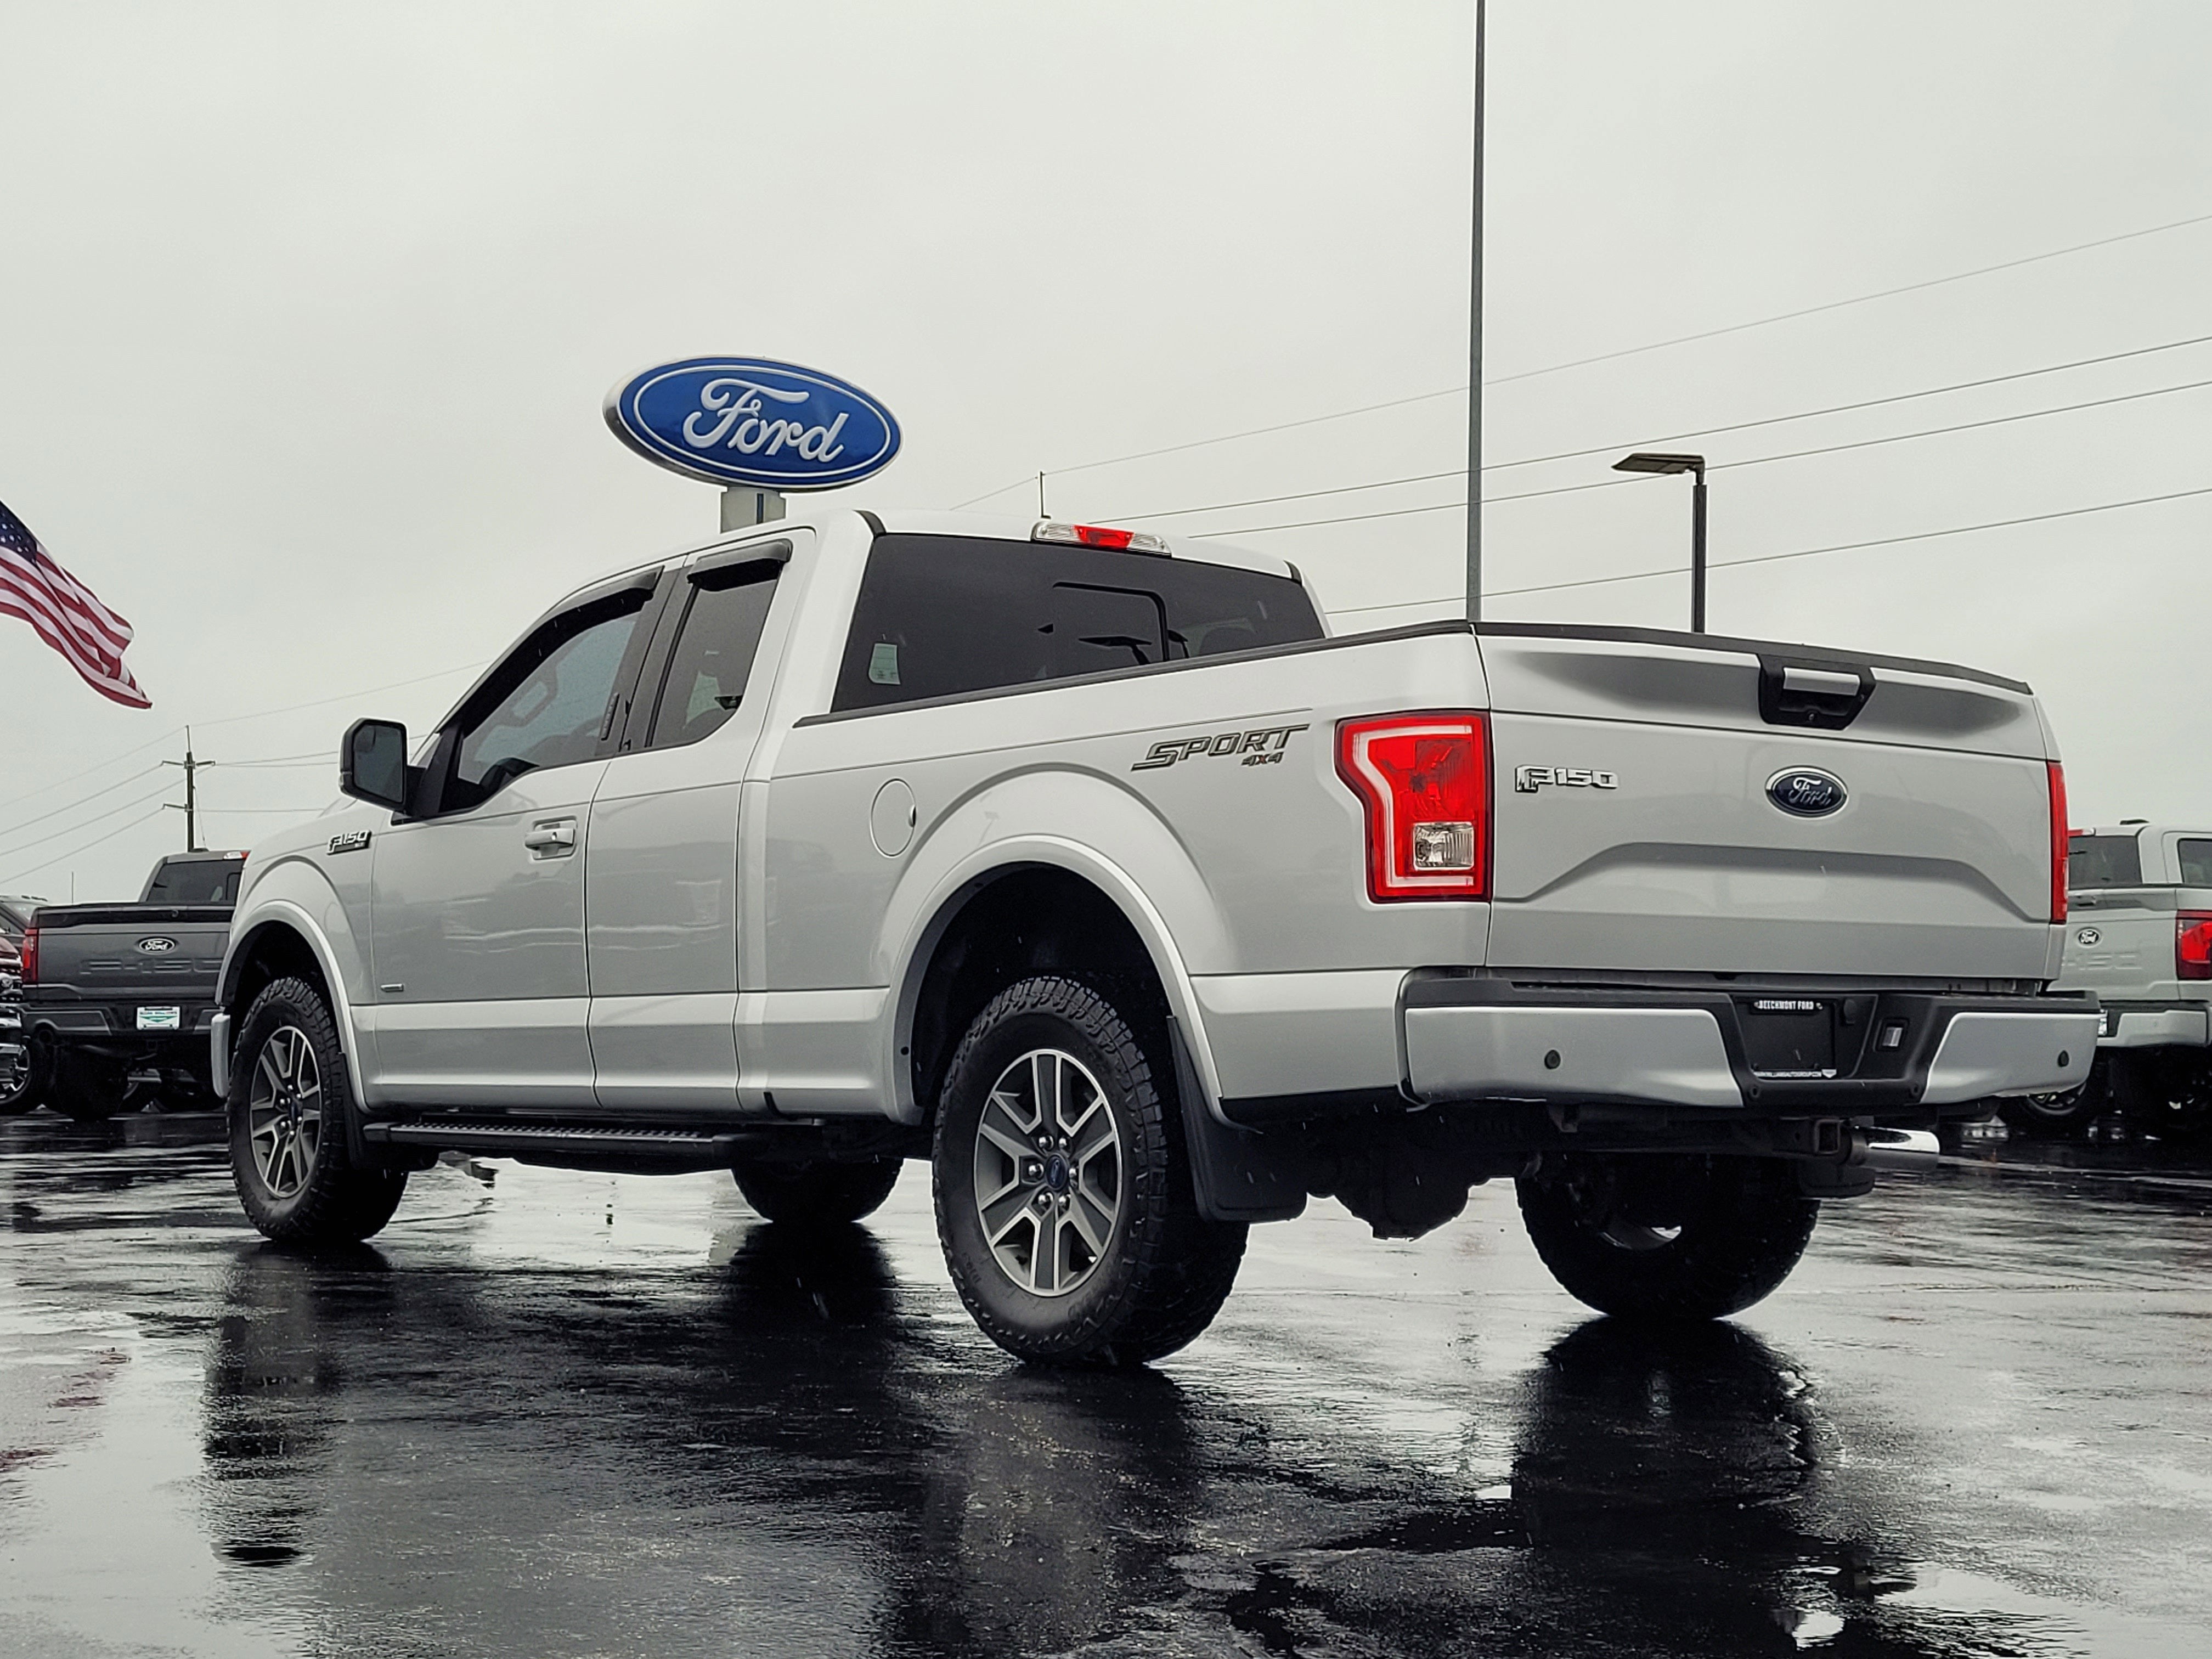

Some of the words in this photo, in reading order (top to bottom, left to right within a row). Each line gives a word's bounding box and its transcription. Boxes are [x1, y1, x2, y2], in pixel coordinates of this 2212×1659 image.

[682, 378, 849, 462] Ford
[1131, 724, 1310, 771] SPORT
[1788, 777, 1832, 806] Ford
[145, 940, 168, 950] Ford
[1798, 1001, 1814, 1009] FORD
